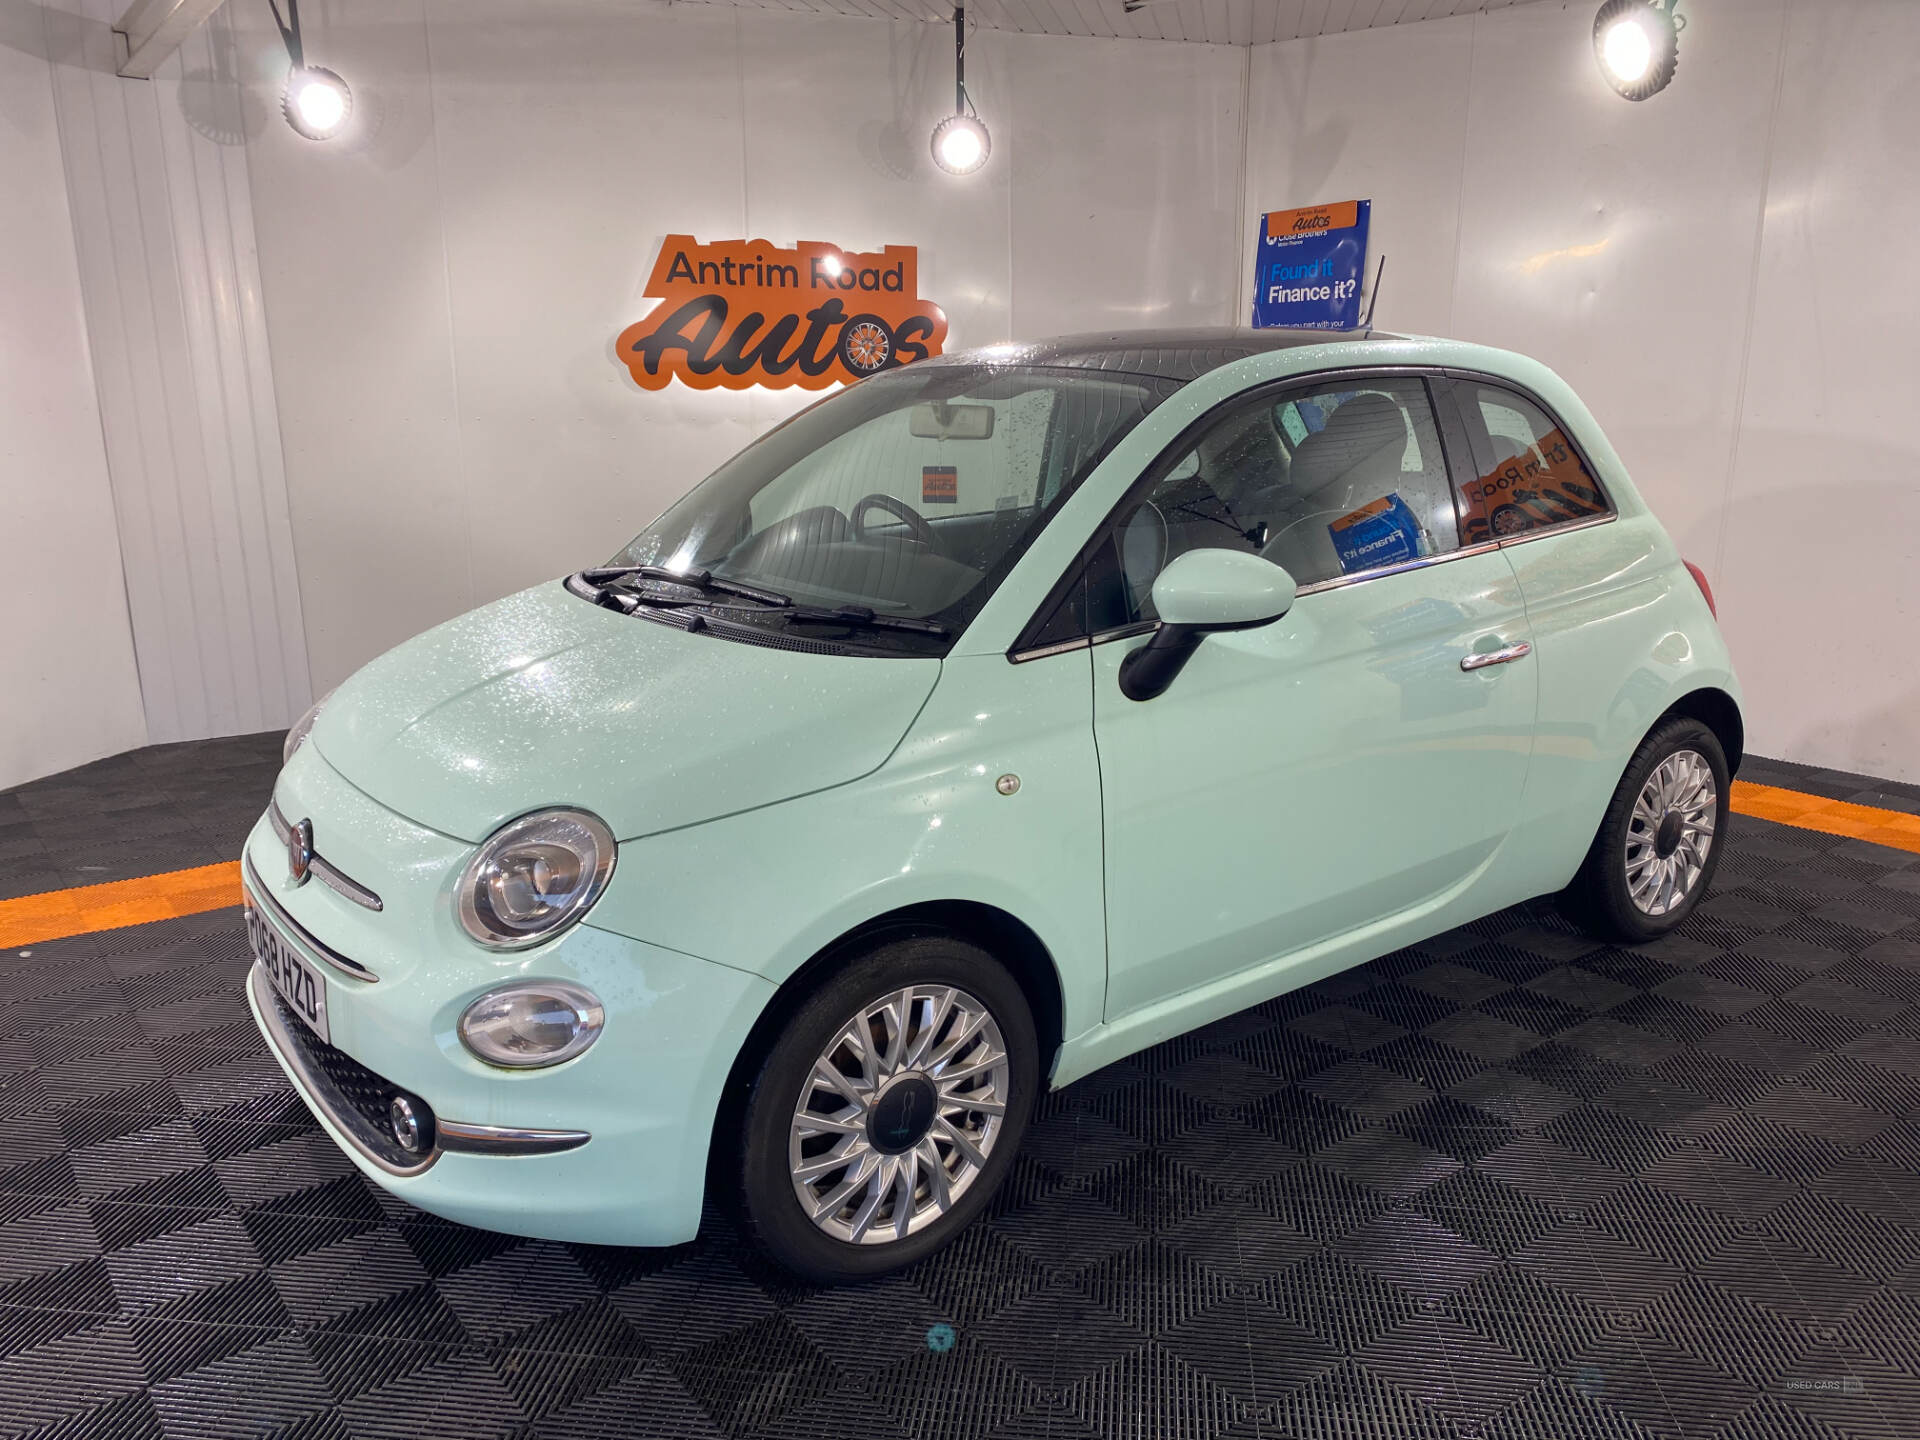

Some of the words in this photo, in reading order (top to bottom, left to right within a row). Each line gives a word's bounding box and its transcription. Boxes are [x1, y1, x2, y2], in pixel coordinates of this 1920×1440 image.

[1292, 215, 1331, 231] Autos
[666, 251, 798, 288] Antrim
[811, 256, 904, 292] Road
[1271, 259, 1319, 281] Found
[1322, 258, 1333, 277] it
[1268, 285, 1330, 304] Finance
[1334, 279, 1356, 299] it?
[632, 294, 935, 379] Autos
[281, 945, 317, 1023] HZD
